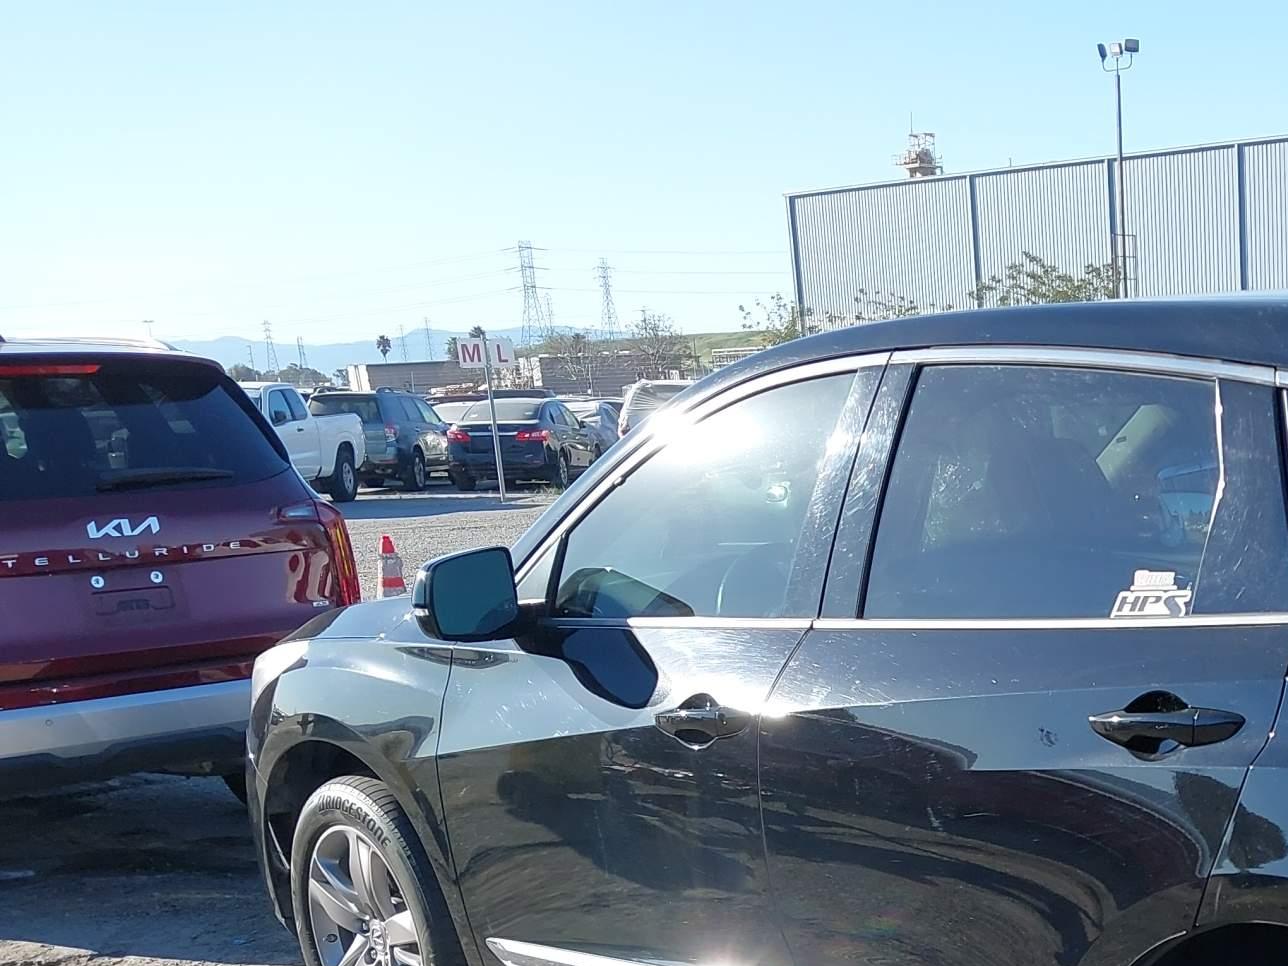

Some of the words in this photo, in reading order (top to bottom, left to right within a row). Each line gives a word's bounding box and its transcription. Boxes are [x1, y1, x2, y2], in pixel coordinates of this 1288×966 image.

[461, 344, 482, 363] M
[496, 344, 509, 363] L
[86, 516, 160, 539] KIA
[1, 541, 241, 568] TELLURIDE
[318, 795, 392, 850] BRIDGESTONE
